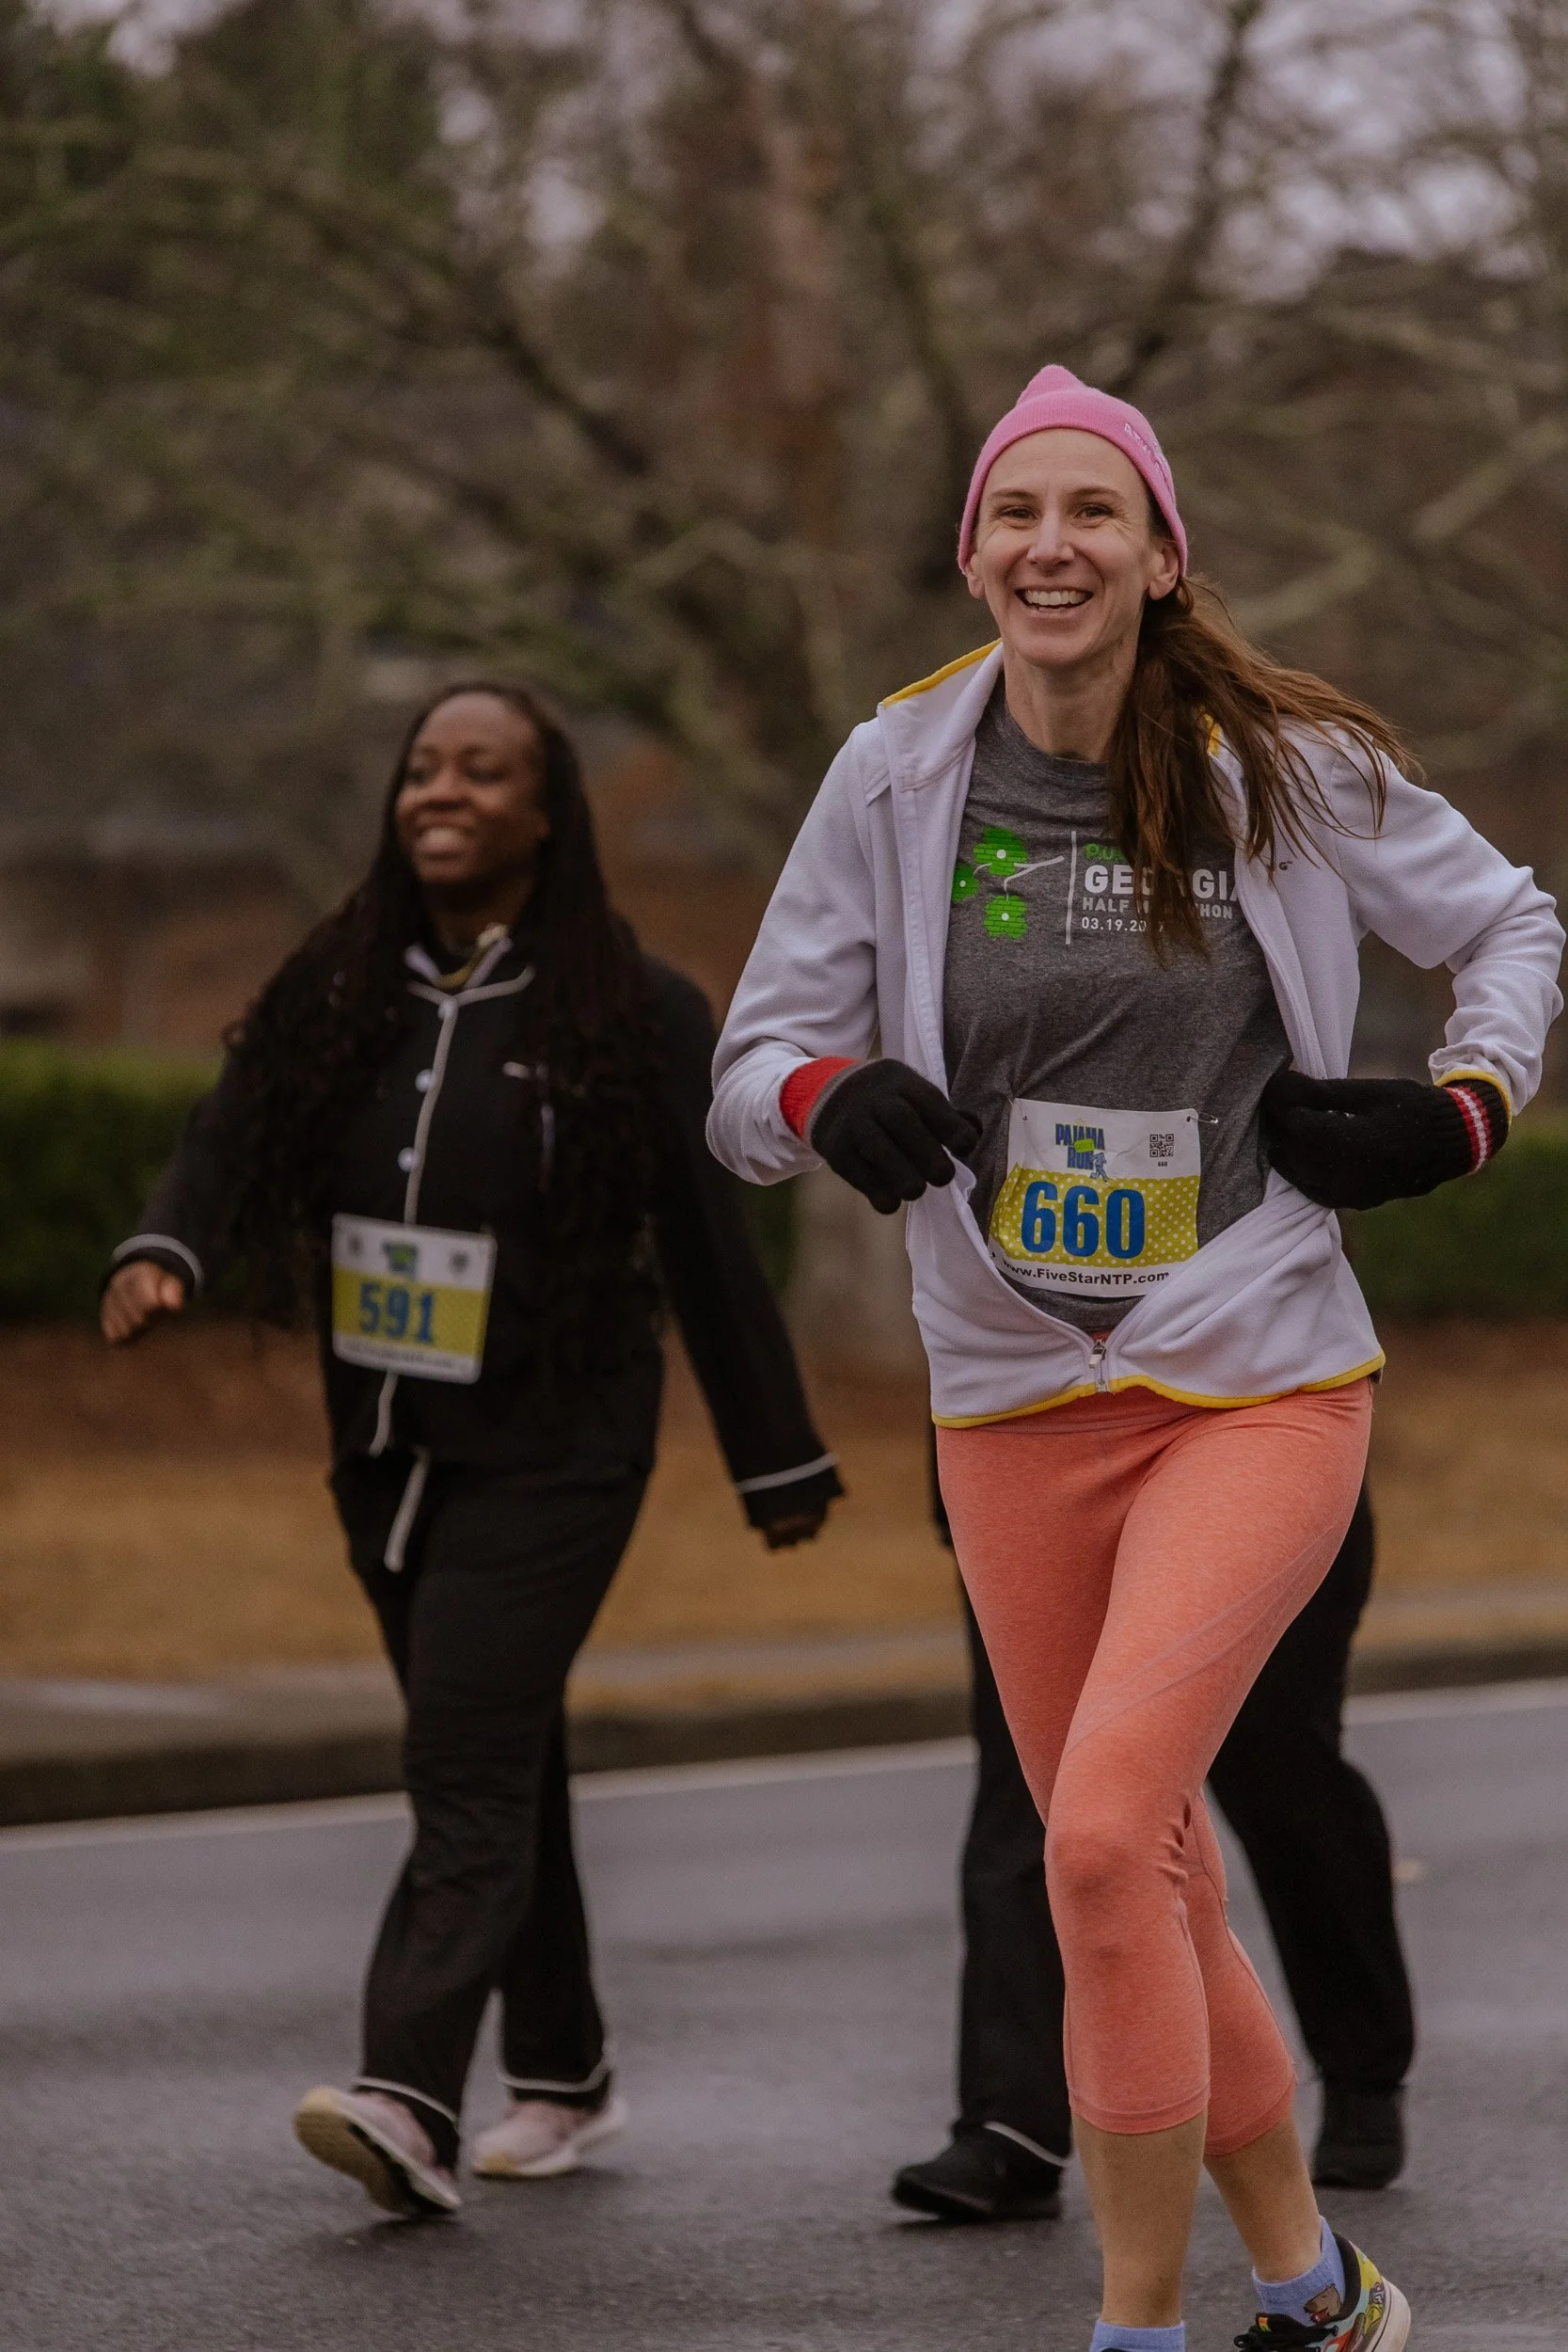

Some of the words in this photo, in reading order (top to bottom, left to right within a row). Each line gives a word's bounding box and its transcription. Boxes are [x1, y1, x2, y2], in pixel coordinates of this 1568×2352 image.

[1082, 898, 1130, 914] HALF
[1068, 1147, 1094, 1170] RUN
[1022, 1182, 1145, 1259] 660
[360, 1283, 434, 1343] 591
